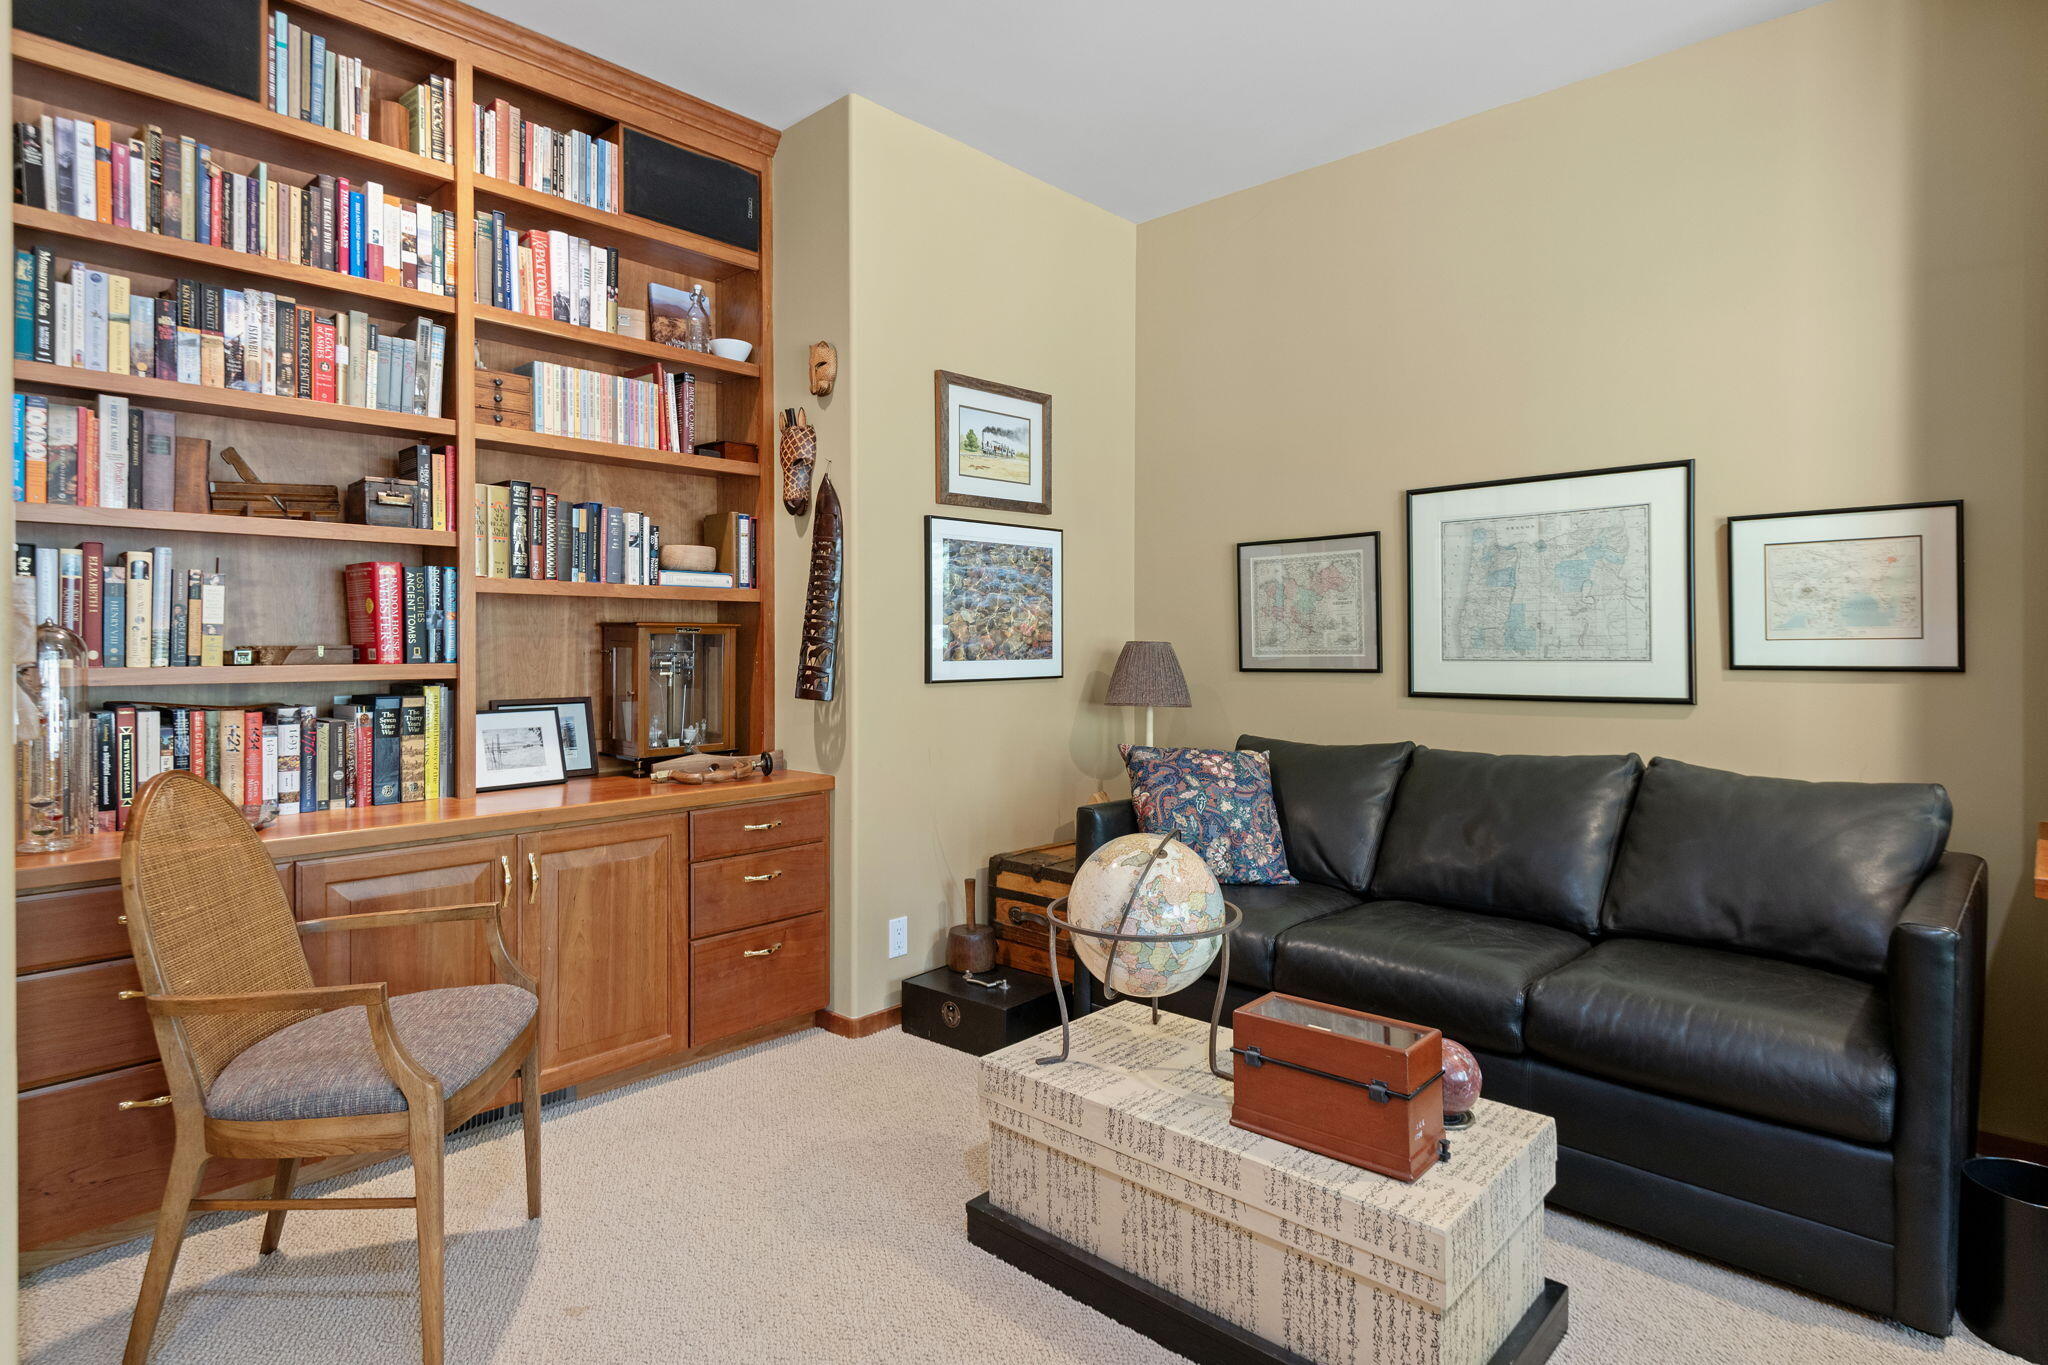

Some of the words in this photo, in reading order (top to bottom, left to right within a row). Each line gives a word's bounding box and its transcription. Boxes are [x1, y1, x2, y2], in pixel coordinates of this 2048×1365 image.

[314, 40, 324, 65] ASTORIA
[323, 197, 332, 210] THE
[323, 210, 332, 231] GREAT
[323, 231, 332, 254] DIVIDE
[39, 250, 51, 291] Monsarrat
[535, 248, 547, 297] PATTON
[39, 292, 49, 300] at
[181, 284, 191, 300] KEN
[206, 288, 215, 305] KEN
[40, 301, 51, 316] Sea
[182, 299, 191, 325] FOLLETT
[206, 303, 215, 329] FOLLETT
[248, 324, 258, 358] ISTANBUL
[300, 326, 310, 342] THE
[316, 325, 324, 333] of
[300, 341, 310, 358] FACE
[316, 332, 325, 359] ASHES
[324, 327, 335, 360] LEGACY
[300, 357, 310, 369] OF
[300, 368, 310, 394] BATTLE
[87, 555, 99, 607] ELIZABETH
[406, 571, 416, 610] ANCIENT
[415, 572, 425, 593] LOST
[431, 569, 440, 607] DISCIPLES
[71, 589, 81, 622] ELEANOR
[390, 577, 399, 617] RANDOM
[416, 596, 425, 623] CITIES
[110, 599, 120, 628] HENRY
[177, 614, 187, 638] WOLF
[378, 578, 392, 653] WEBSTER'S
[110, 629, 120, 645] VIII
[391, 619, 400, 652] HOUSE
[407, 614, 417, 644] TOMBS
[177, 638, 186, 659] HALL
[432, 699, 440, 733] pictorial
[123, 738, 131, 750] THE
[194, 732, 203, 757] GREAT
[224, 724, 241, 753] 1421
[249, 727, 261, 750] 1434
[286, 728, 300, 751] 1493
[301, 729, 317, 756] 1776
[347, 724, 356, 750] EMPIRES
[431, 733, 440, 763] history
[102, 752, 112, 776] skeptical
[123, 750, 131, 771] TWELVE
[347, 759, 355, 772] SEA
[433, 763, 440, 771] of
[123, 770, 131, 794] CAESARS
